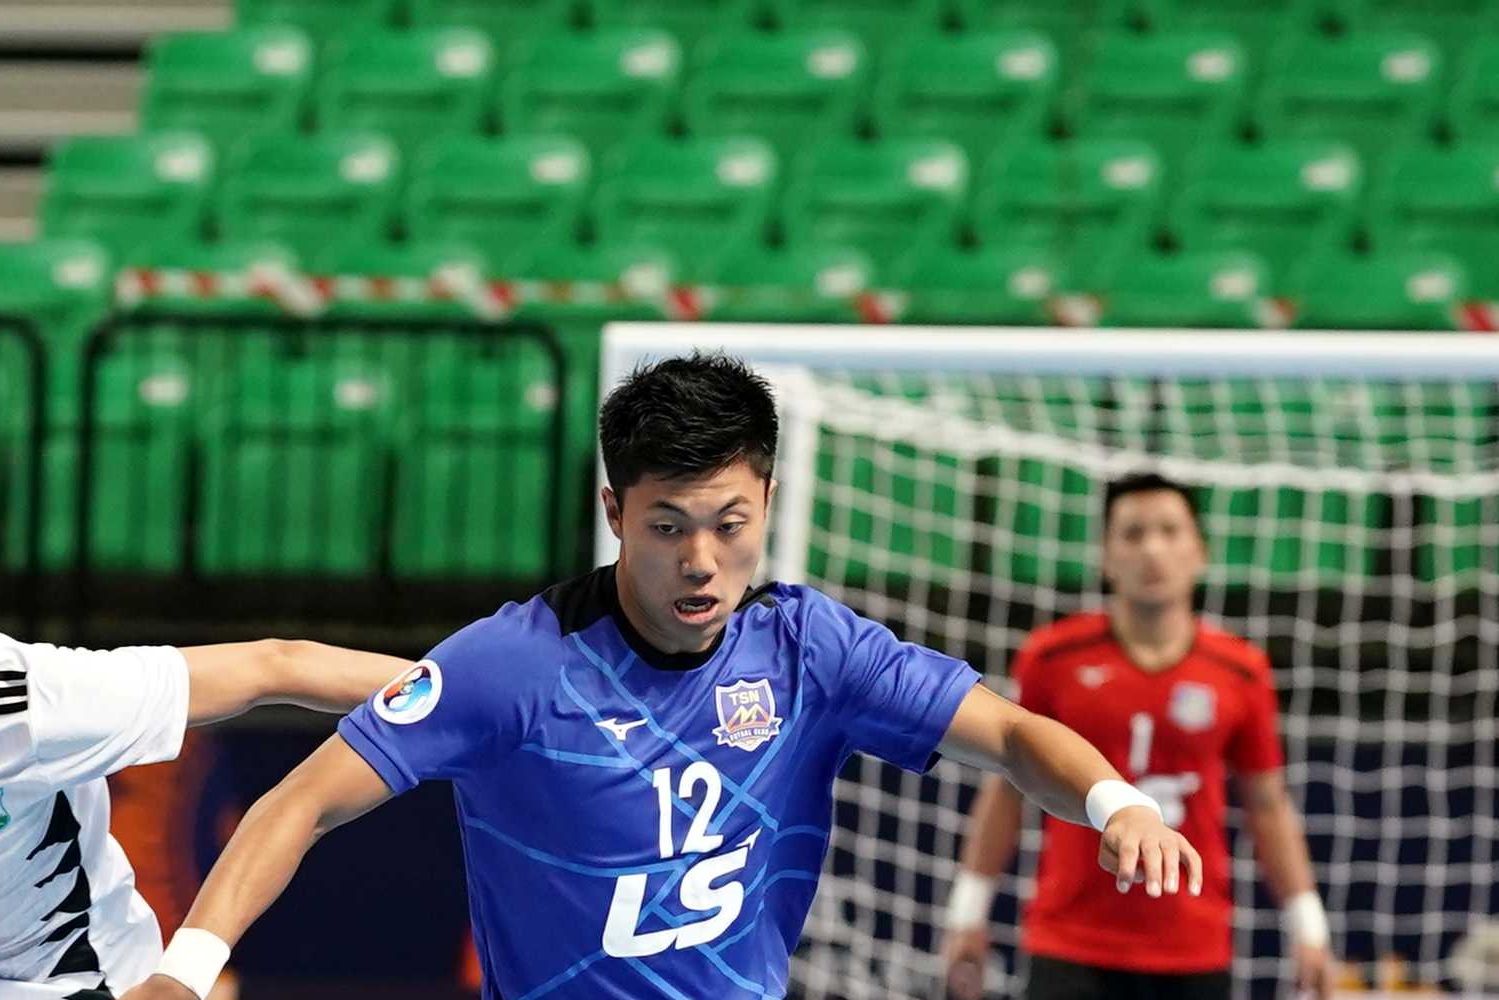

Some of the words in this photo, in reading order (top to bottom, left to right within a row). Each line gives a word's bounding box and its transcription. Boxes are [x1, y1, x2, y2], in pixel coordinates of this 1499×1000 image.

[728, 690, 760, 706] TSN
[1128, 713, 1154, 774] 1
[653, 761, 724, 859] 12
[602, 847, 749, 957] LS
